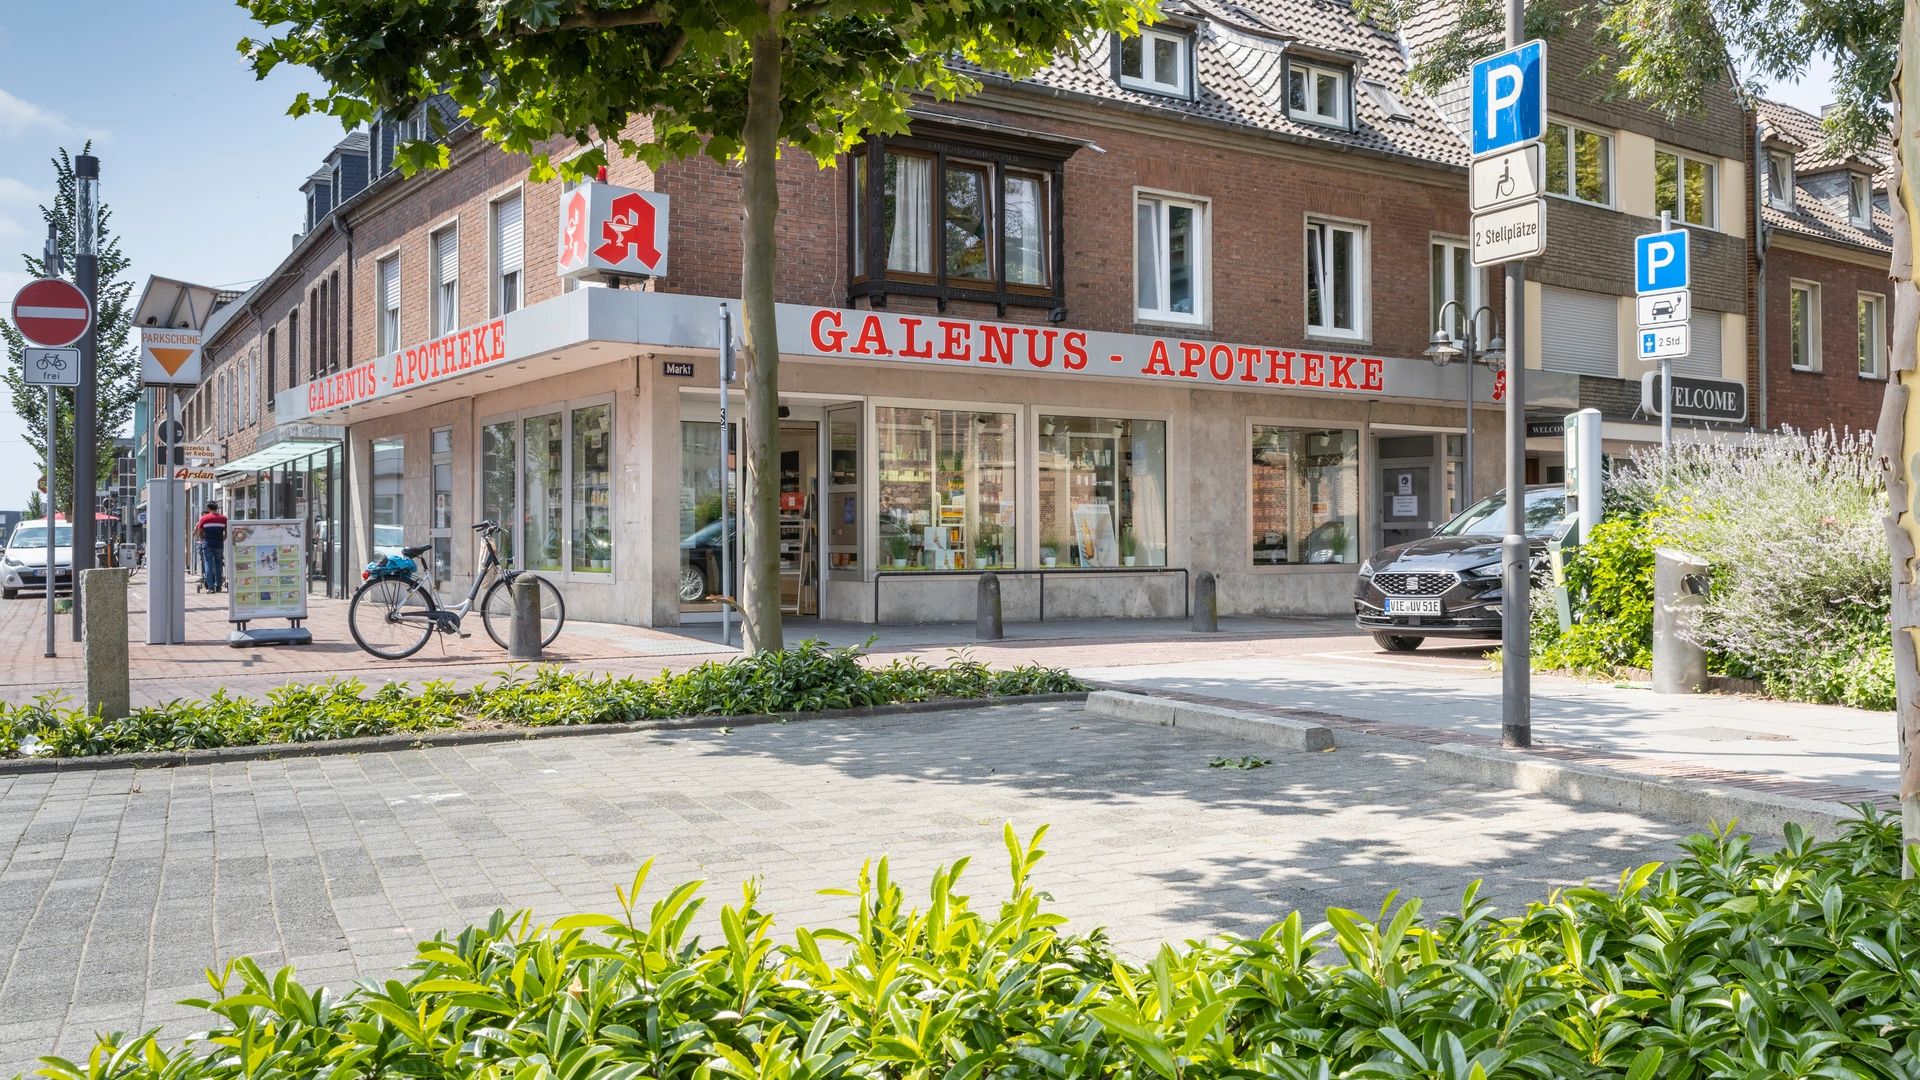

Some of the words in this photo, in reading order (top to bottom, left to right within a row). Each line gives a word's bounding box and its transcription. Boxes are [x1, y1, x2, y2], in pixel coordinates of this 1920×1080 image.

[1487, 64, 1524, 139] P
[1475, 232, 1481, 247] 2
[1485, 222, 1537, 245] Stellplätze
[1648, 241, 1675, 285] P
[142, 333, 200, 345] PARKSCHEINE
[1658, 338, 1664, 347] 2
[809, 309, 1088, 371] GALENUS
[1141, 338, 1384, 392] APOTHEKE
[308, 361, 376, 413] GALENUS
[392, 319, 505, 389] APOTHEKE
[666, 363, 691, 375] Markt
[43, 371, 60, 380] frei
[175, 467, 214, 480] Arslan
[1391, 600, 1405, 612] VIE
[1410, 601, 1421, 612] UV
[1423, 601, 1439, 612] 51E
